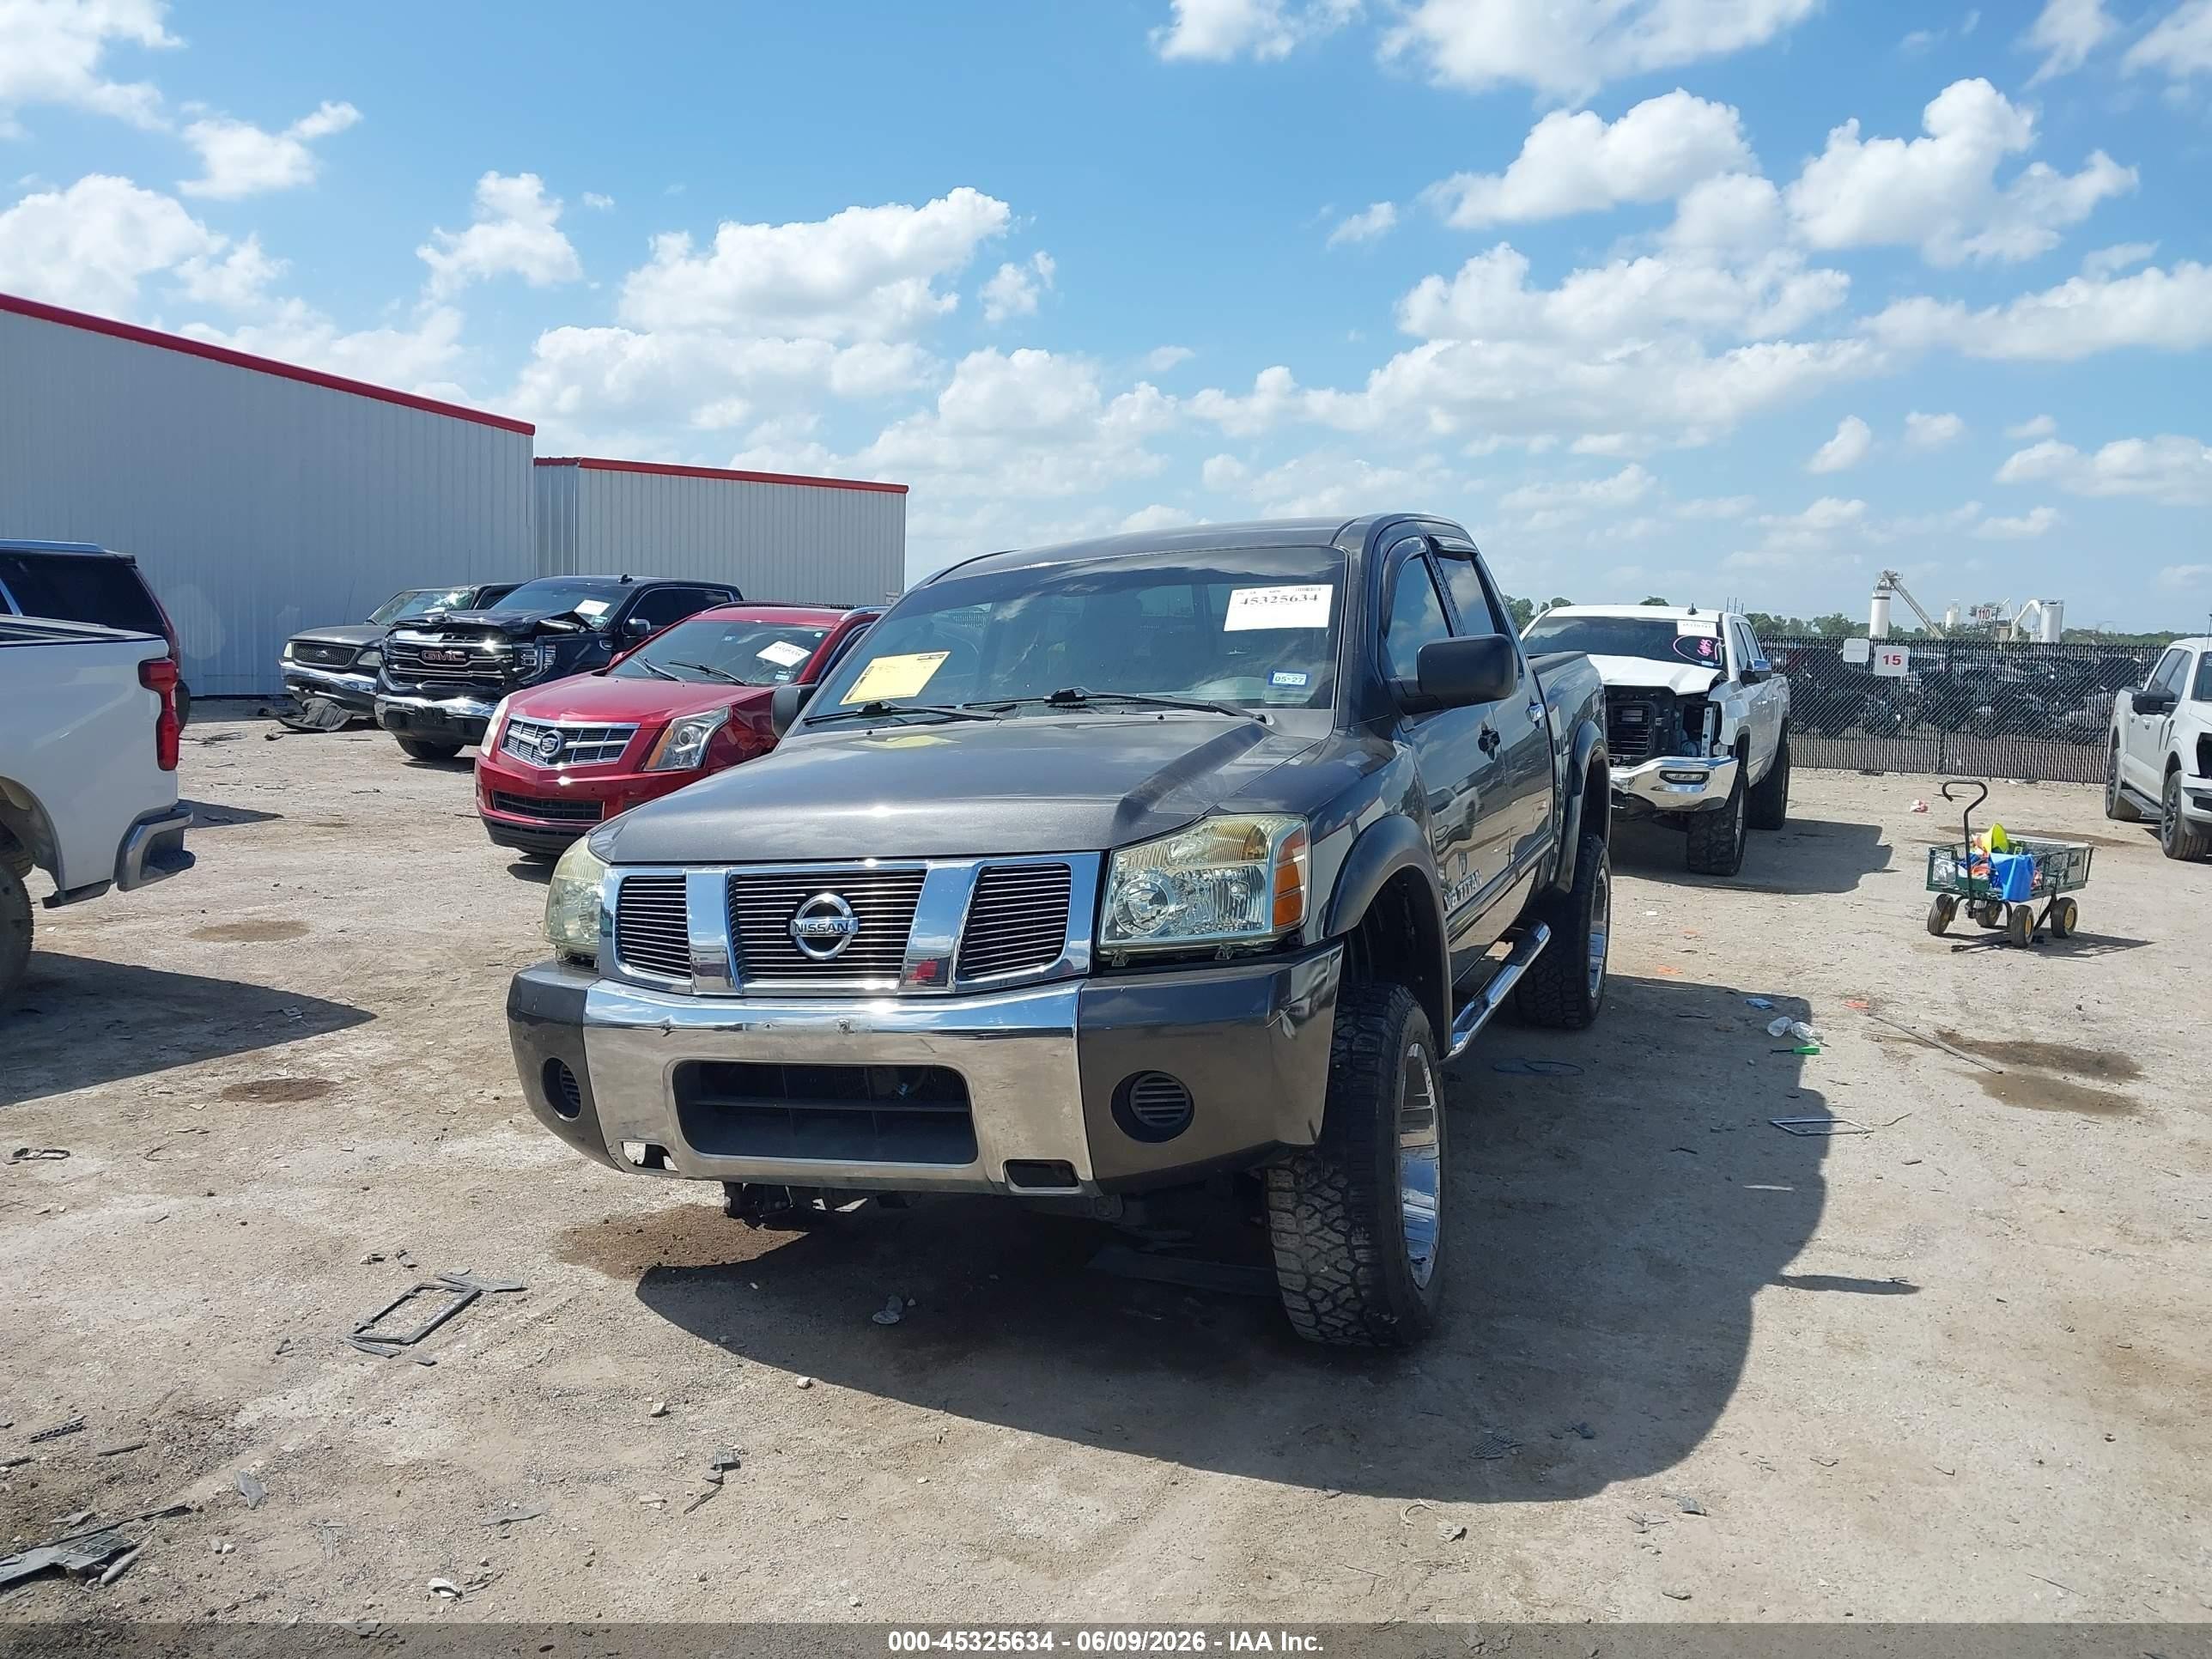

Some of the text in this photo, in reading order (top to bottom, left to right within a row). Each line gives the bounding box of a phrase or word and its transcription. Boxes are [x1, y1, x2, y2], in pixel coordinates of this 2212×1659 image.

[1239, 593, 1318, 605] 45325634
[421, 649, 466, 662] GMC
[1882, 654, 1902, 666] 15
[794, 922, 849, 933] NISSAN
